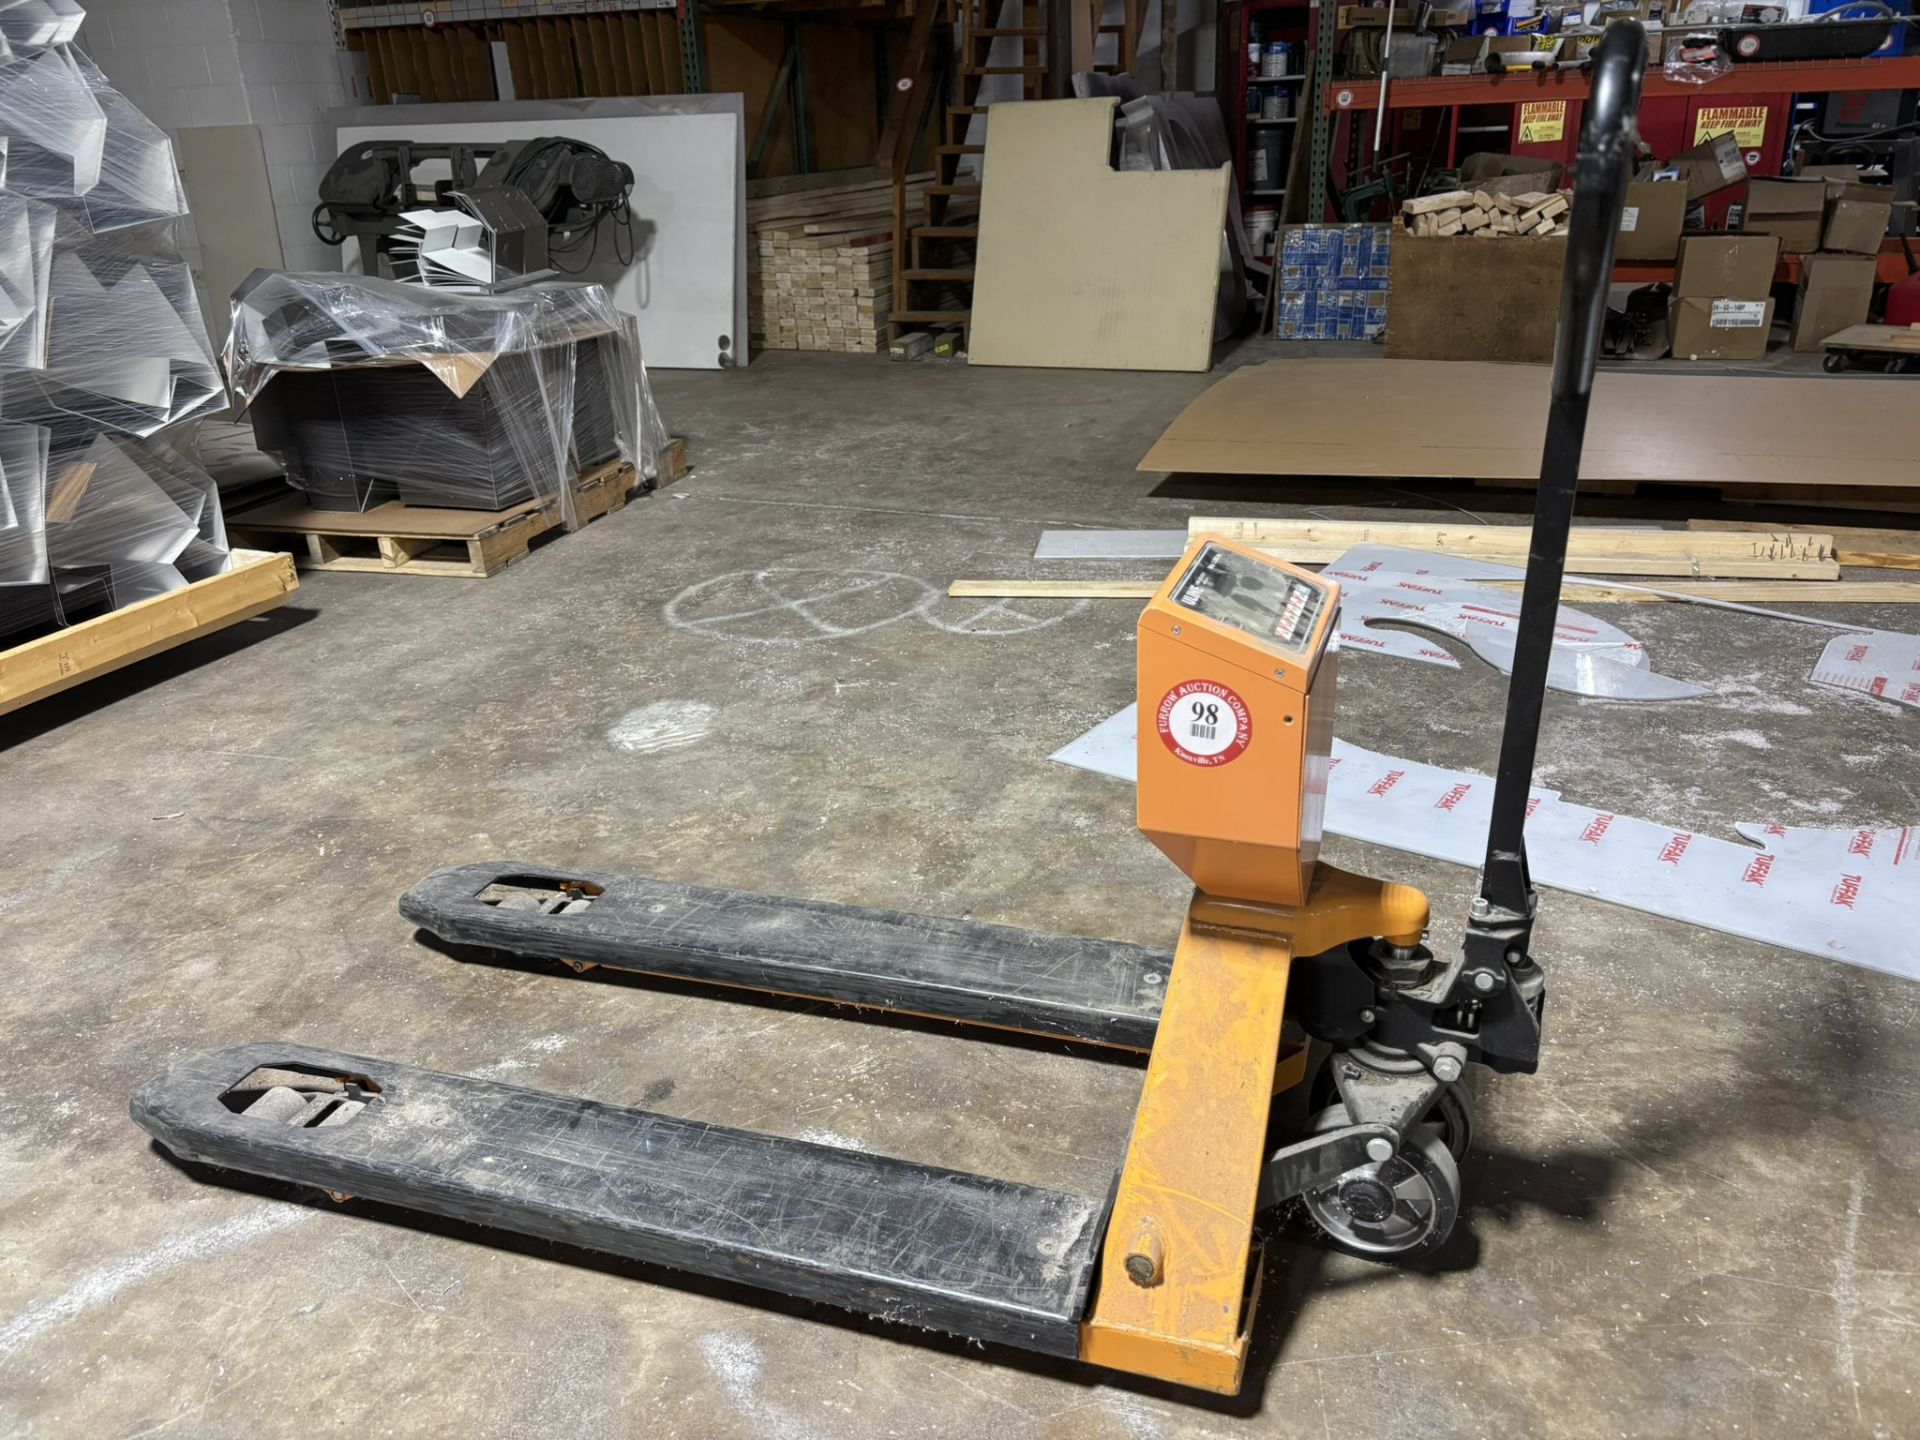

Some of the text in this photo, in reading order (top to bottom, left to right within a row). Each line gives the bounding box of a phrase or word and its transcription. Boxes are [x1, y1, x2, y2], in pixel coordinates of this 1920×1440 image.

[1701, 107, 1765, 120] FLAMMABLE
[1701, 119, 1764, 129] KEEP FIRE AWAY
[1381, 598, 1425, 612] TUFFAK
[1457, 613, 1506, 627] TUFFAK
[1158, 682, 1249, 749] FURROW AUCTION COMPANY
[1191, 701, 1219, 725] 98
[1370, 770, 1405, 797] TUFFAK
[1437, 783, 1472, 811] TUFFAK
[1583, 813, 1615, 845] TUFFAK
[1662, 832, 1693, 865] TUFFAK
[1745, 852, 1776, 886] TUFFAK
[1834, 873, 1862, 909] TUFFAK
